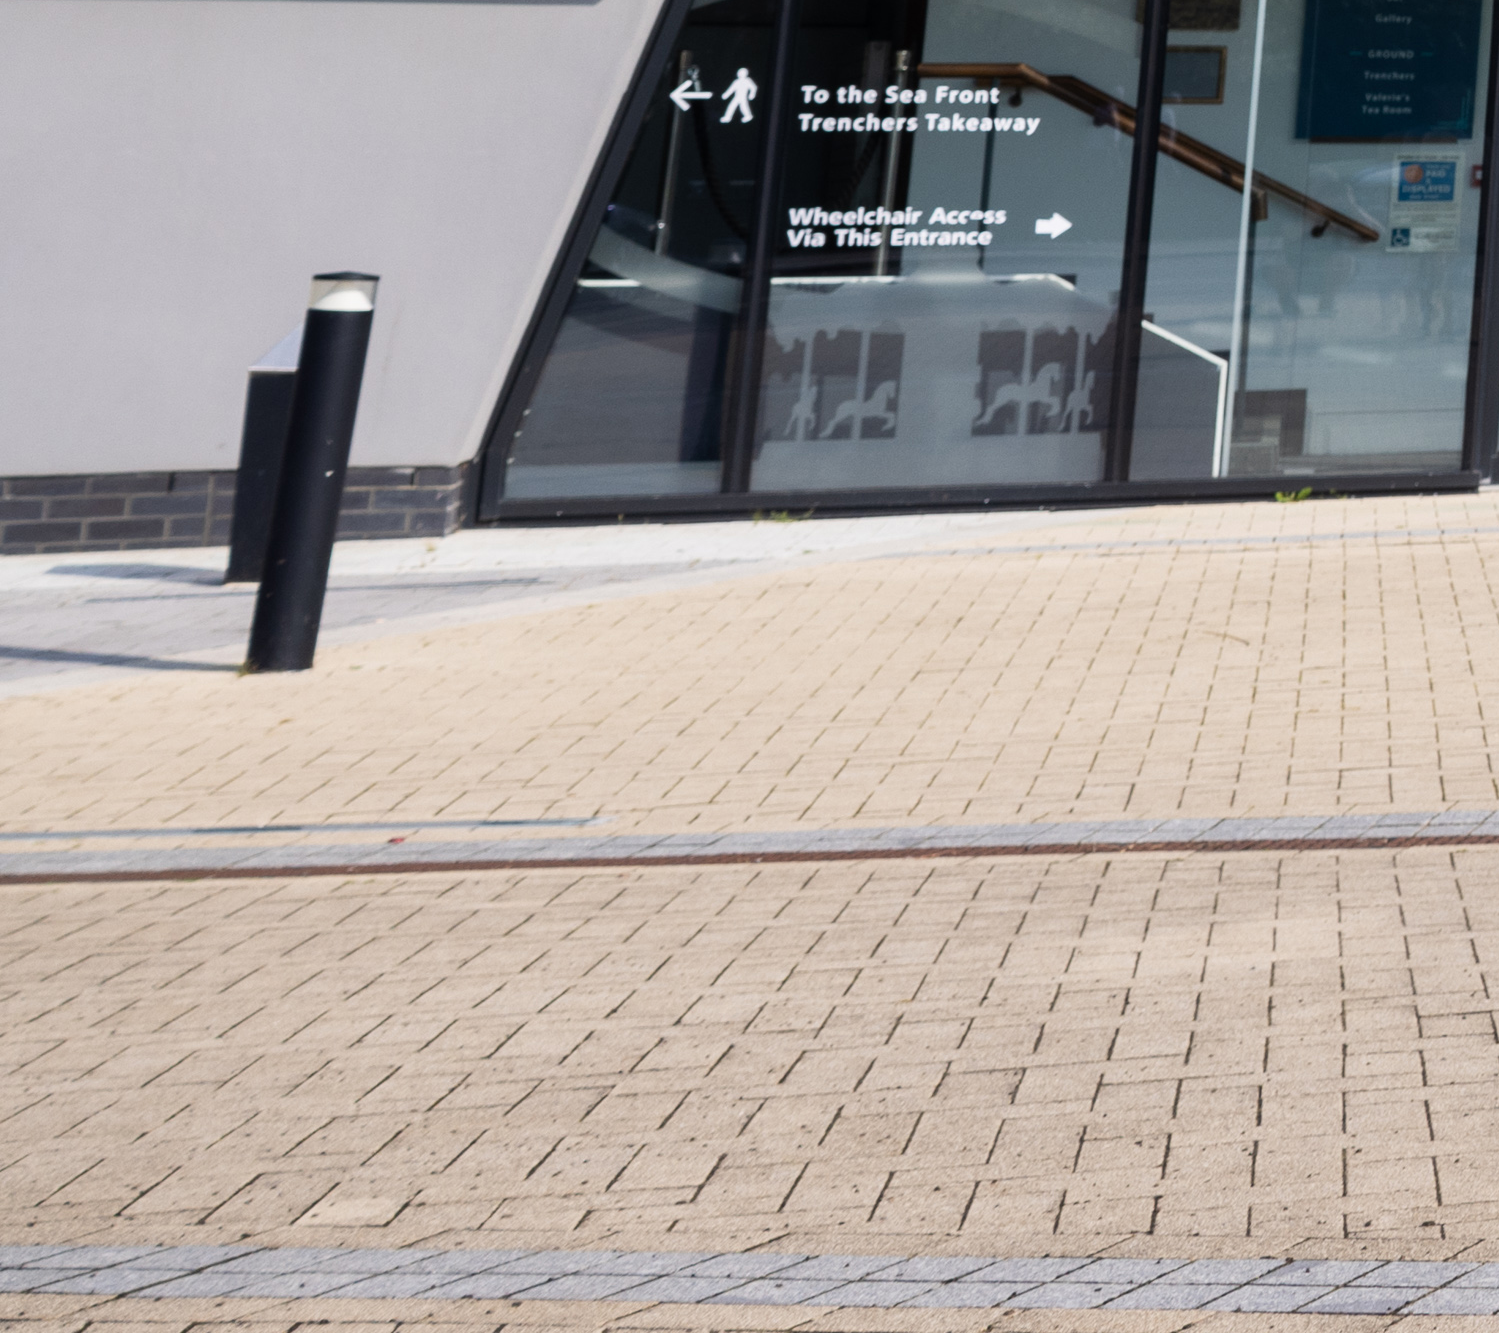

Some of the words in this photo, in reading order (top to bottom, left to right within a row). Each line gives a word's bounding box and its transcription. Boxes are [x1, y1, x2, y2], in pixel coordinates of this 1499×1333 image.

[1375, 14, 1412, 25] Gallery
[1367, 50, 1415, 59] GROUND
[1364, 71, 1415, 81] Trenchers
[800, 84, 830, 104] To
[836, 85, 878, 104] the
[884, 85, 927, 105] Sea
[934, 85, 1000, 104] Front
[1365, 93, 1410, 102] Valerie's
[1361, 105, 1380, 114] Tea
[1382, 105, 1412, 114] Room
[798, 113, 918, 132] Trenchers
[924, 113, 1041, 136] Takeaway
[788, 206, 923, 226] Wheelchair
[786, 228, 826, 247] Via
[834, 228, 883, 247] This
[890, 228, 993, 247] Entrance
